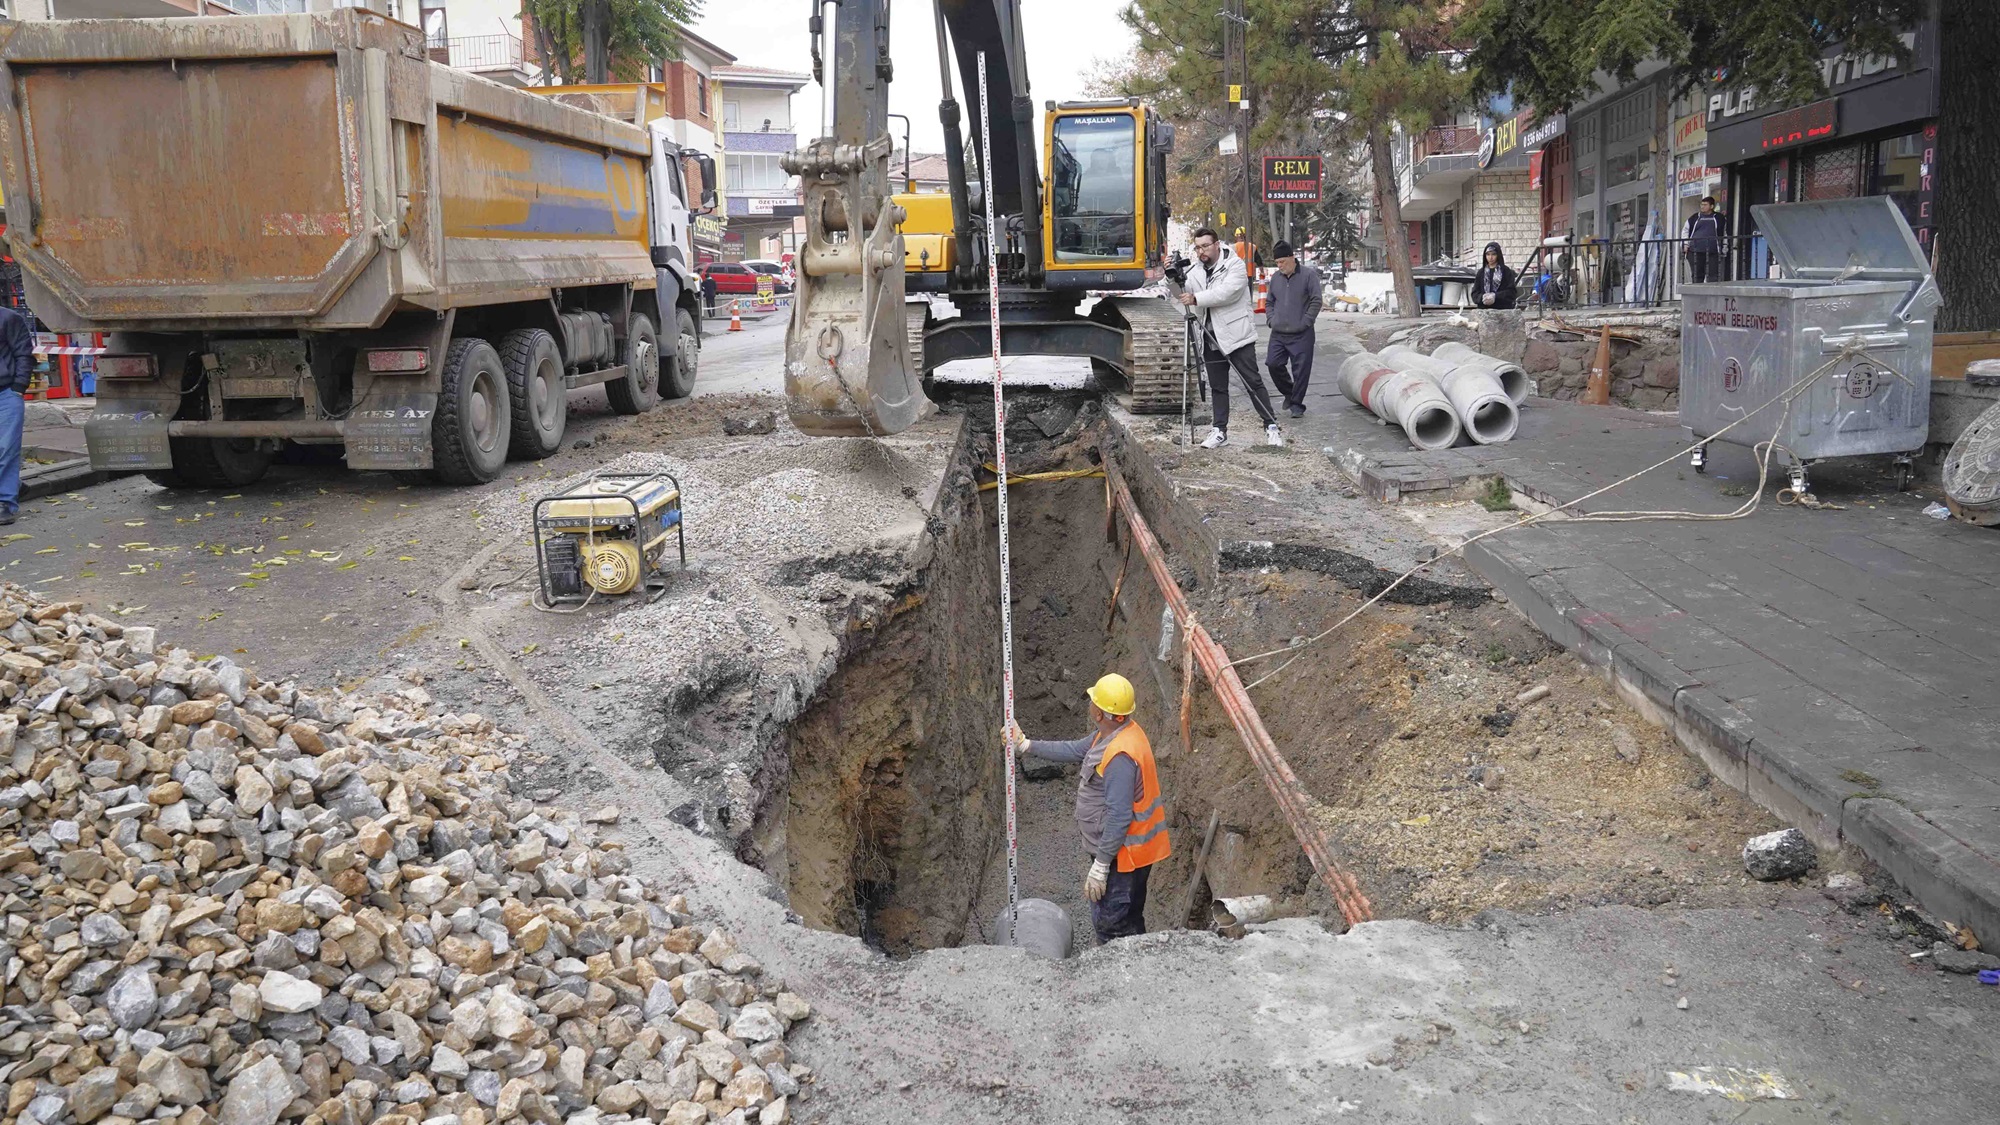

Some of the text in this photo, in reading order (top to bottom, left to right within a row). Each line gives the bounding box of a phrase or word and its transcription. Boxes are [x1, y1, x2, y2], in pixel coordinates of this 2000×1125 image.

[1074, 117, 1116, 126] MAŞALLAH
[1496, 117, 1517, 157] REM
[1527, 131, 1536, 147] 536
[1545, 123, 1551, 138] 97
[1551, 120, 1557, 134] 61
[1274, 160, 1311, 176] REM
[1268, 180, 1317, 191] YAPI MARKET
[1724, 298, 1738, 311] T.C.
[1731, 314, 1778, 331] BELEDİYESİ
